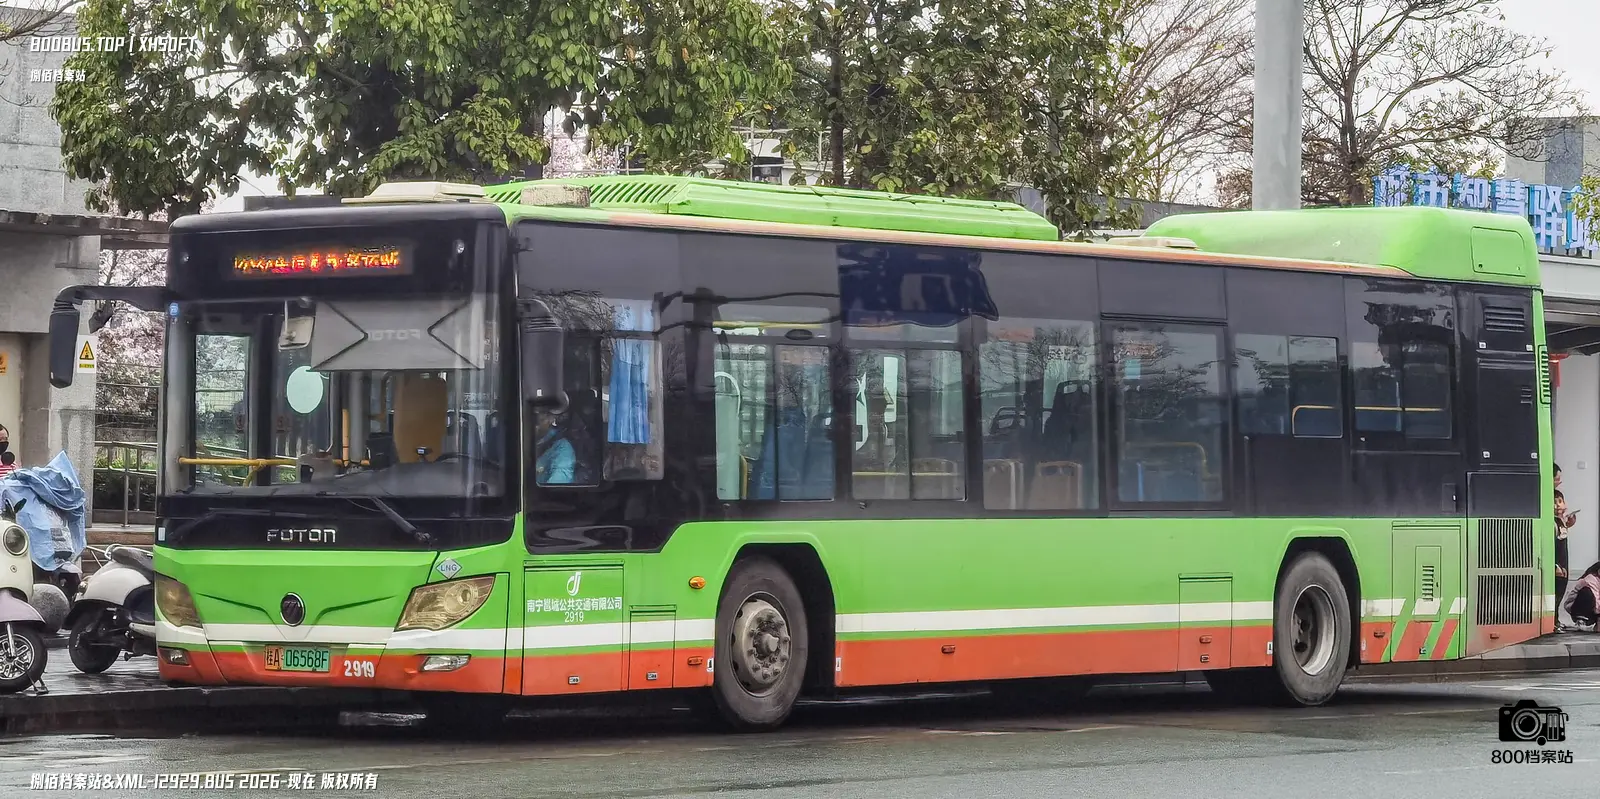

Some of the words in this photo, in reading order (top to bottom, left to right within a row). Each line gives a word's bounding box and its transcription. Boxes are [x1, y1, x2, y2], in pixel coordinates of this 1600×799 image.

[266, 528, 336, 543] FOTON
[440, 564, 458, 572] LNG
[526, 596, 623, 613] 南宁邕城公共交通有限公司
[564, 611, 584, 623] 2919
[344, 660, 375, 678] 2919
